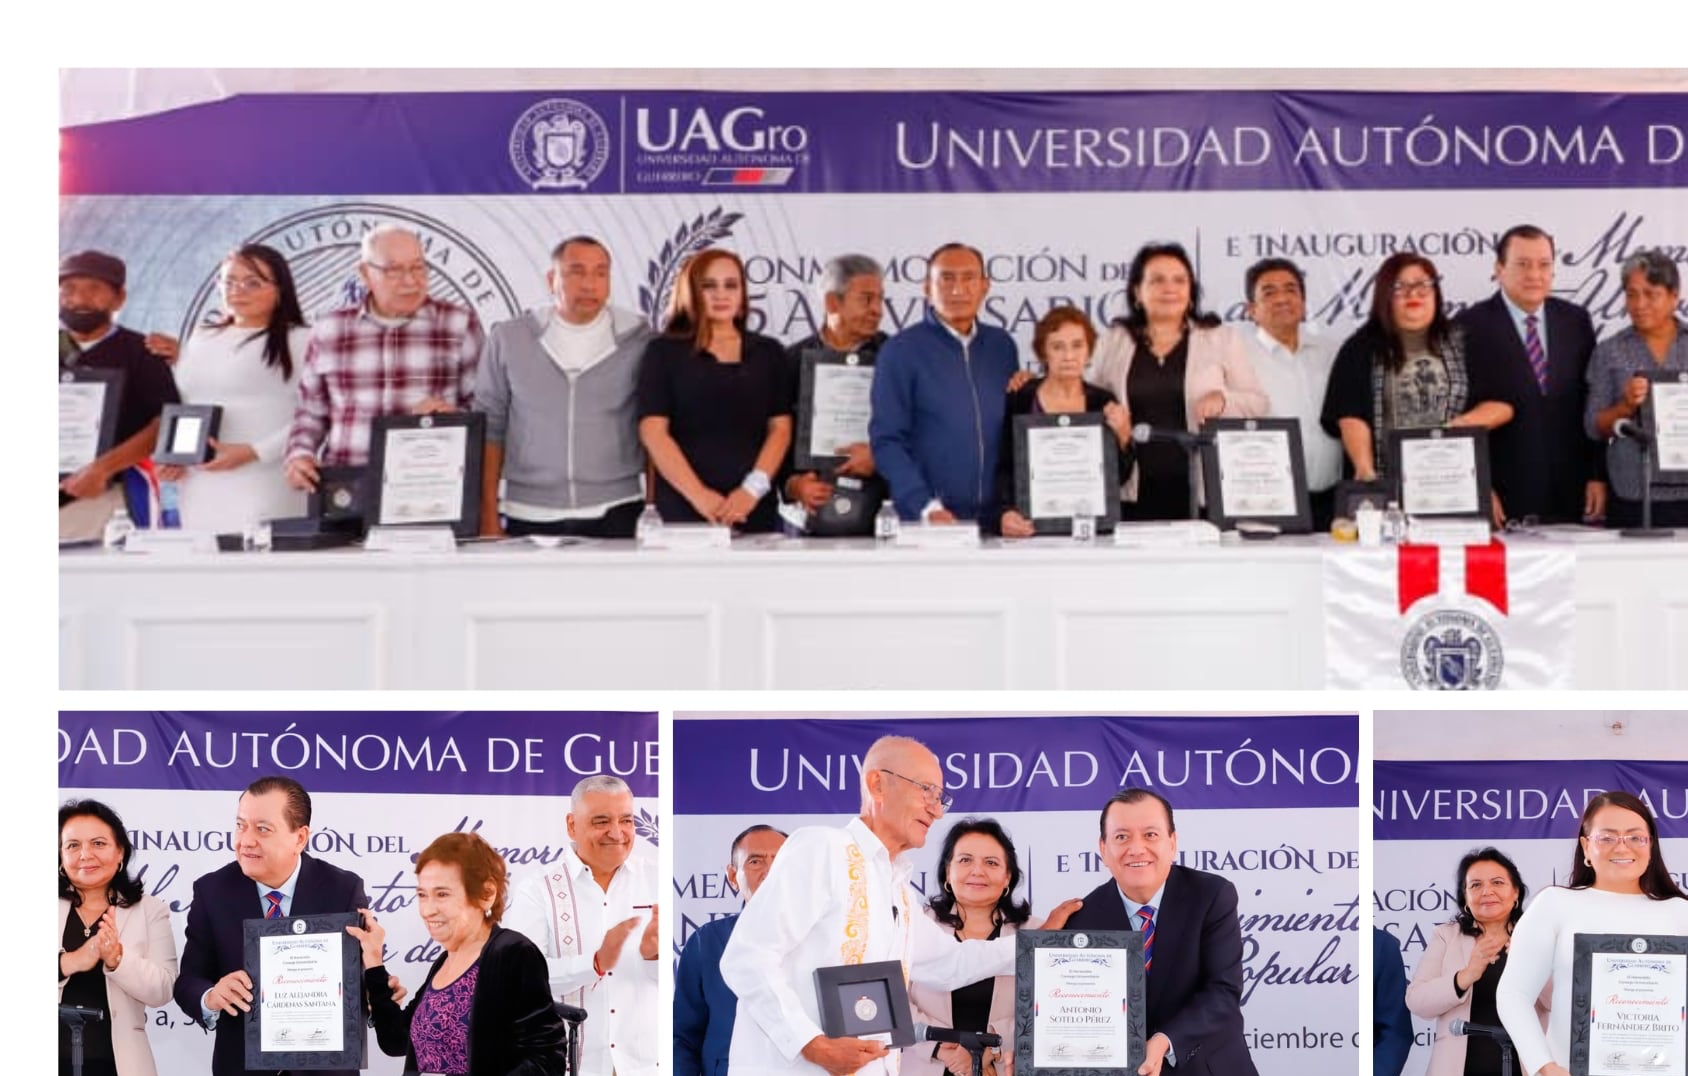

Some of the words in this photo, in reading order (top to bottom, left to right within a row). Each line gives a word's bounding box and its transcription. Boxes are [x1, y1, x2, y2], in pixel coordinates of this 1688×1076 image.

[637, 107, 807, 153] UAGro
[896, 121, 1273, 170] UNIVERSIDAD
[1293, 114, 1626, 167] AUTÓNOMA
[1227, 238, 1242, 258] E
[462, 269, 496, 305] DE
[58, 727, 147, 766] DAD
[168, 721, 468, 773] AUTÓNOMA
[487, 737, 544, 774] DE
[1119, 738, 1359, 789] AUTÓNO
[367, 835, 410, 853] DEL
[1056, 855, 1070, 873] E
[1048, 988, 1112, 998] Reconocimiento
[1606, 994, 1669, 1005] Reconocimiento
[1050, 1015, 1083, 1023] SOTELO
[1085, 1015, 1111, 1023] PÉREZ
[1060, 1006, 1102, 1014] ANTONIO
[1617, 1012, 1660, 1021] VICTORIA
[1597, 1020, 1650, 1031] FERNÁNDEZ
[1652, 1024, 1679, 1032] BRITO
